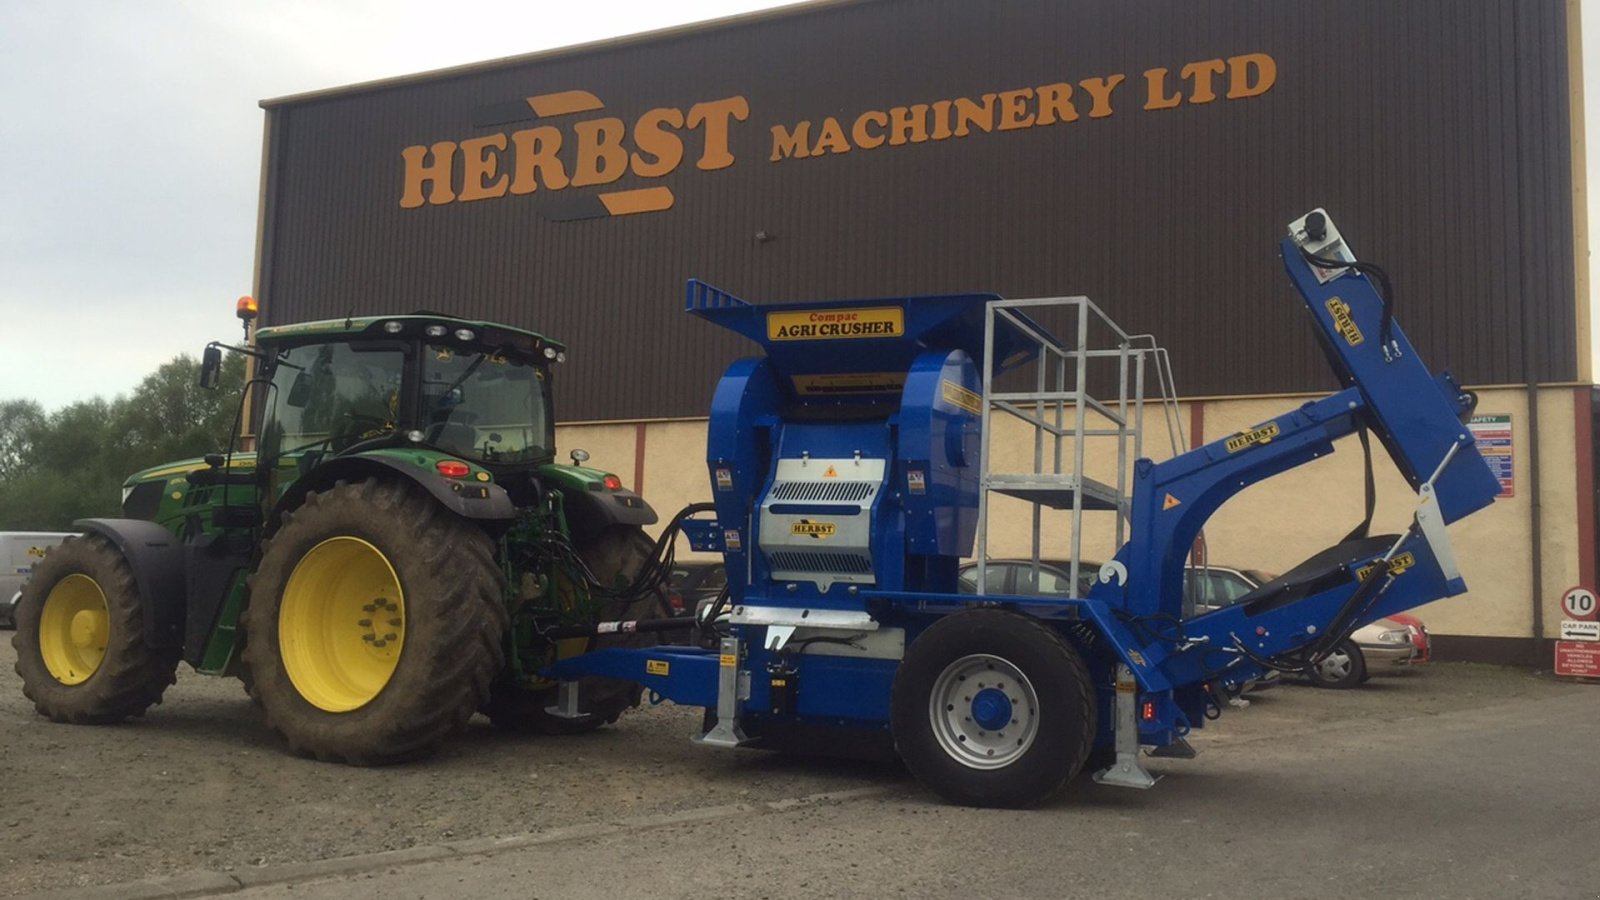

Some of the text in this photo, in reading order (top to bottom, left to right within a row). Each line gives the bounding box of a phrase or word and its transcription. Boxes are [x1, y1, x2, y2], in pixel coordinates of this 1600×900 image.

[400, 53, 1278, 208] HERBST MACHINERY LTD
[809, 313, 858, 323] Compac
[1330, 301, 1360, 342] HERBST
[777, 321, 894, 337] AGRI CRUSHER
[1228, 425, 1274, 450] HERBST
[794, 525, 833, 533] HERBST
[1568, 594, 1592, 611] 10
